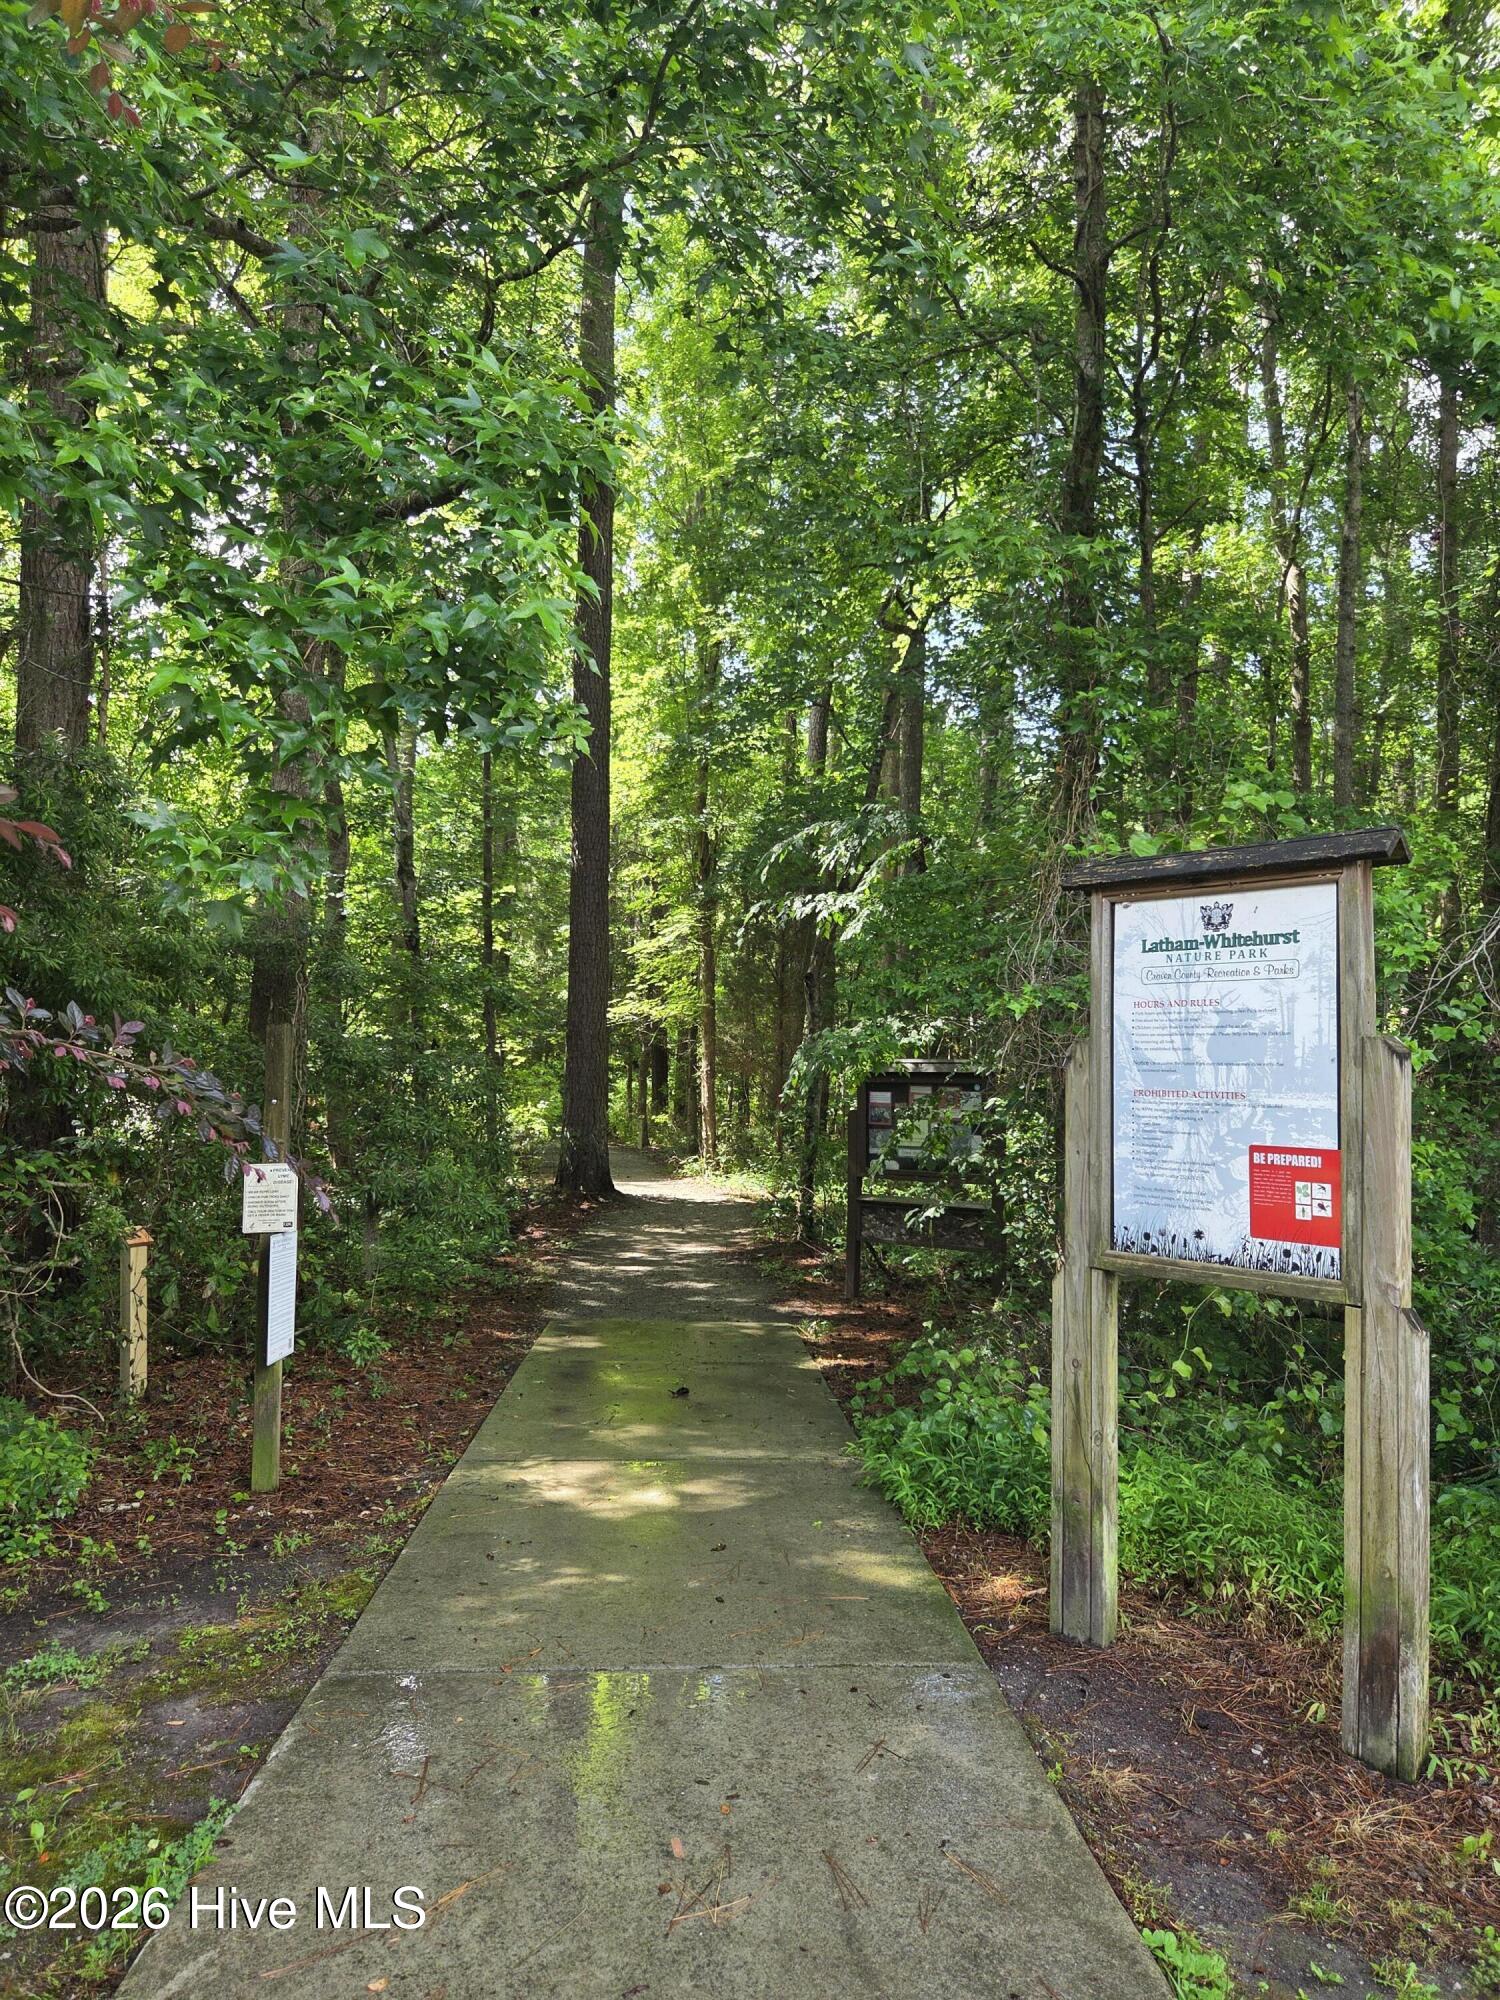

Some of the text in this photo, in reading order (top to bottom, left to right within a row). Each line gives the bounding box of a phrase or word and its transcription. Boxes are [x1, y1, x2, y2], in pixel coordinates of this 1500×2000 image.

[1141, 929, 1300, 953] Latham-Whitehurst
[1166, 948, 1268, 964] NATURE PARK
[1145, 963, 1294, 984] Craven County Recreation & Parks
[1133, 999, 1220, 1009] HOURS AND RULES
[1133, 1089, 1246, 1100] PROHIBITED ACTIVITIES
[1253, 1152, 1322, 1168] BE PREPARED!
